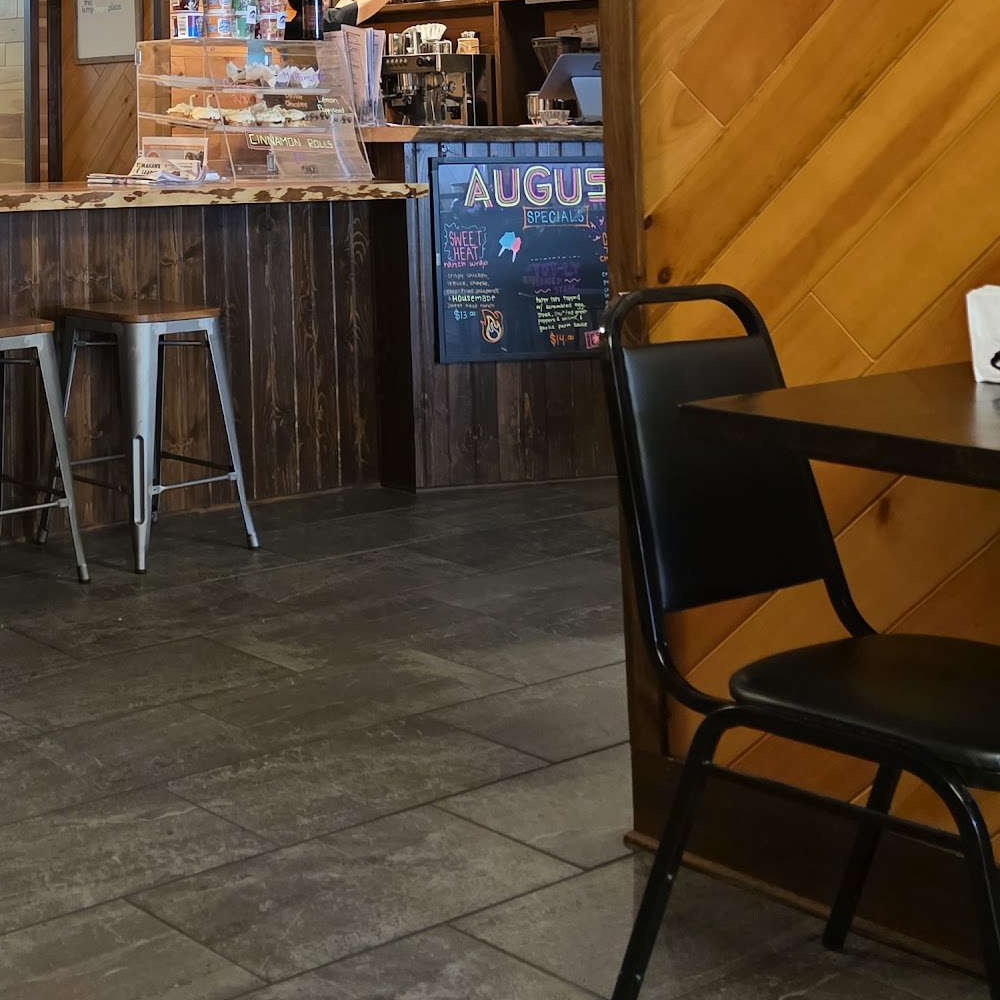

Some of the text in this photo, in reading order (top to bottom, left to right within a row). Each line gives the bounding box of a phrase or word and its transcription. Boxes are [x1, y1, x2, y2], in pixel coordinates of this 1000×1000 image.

[316, 95, 339, 105] Lemon
[249, 133, 334, 149] CINNAMON ROLLS
[526, 209, 585, 224] SPECIALS
[448, 229, 483, 247] SWEET
[453, 246, 480, 262] HEAT
[443, 260, 489, 270] ranch wrap
